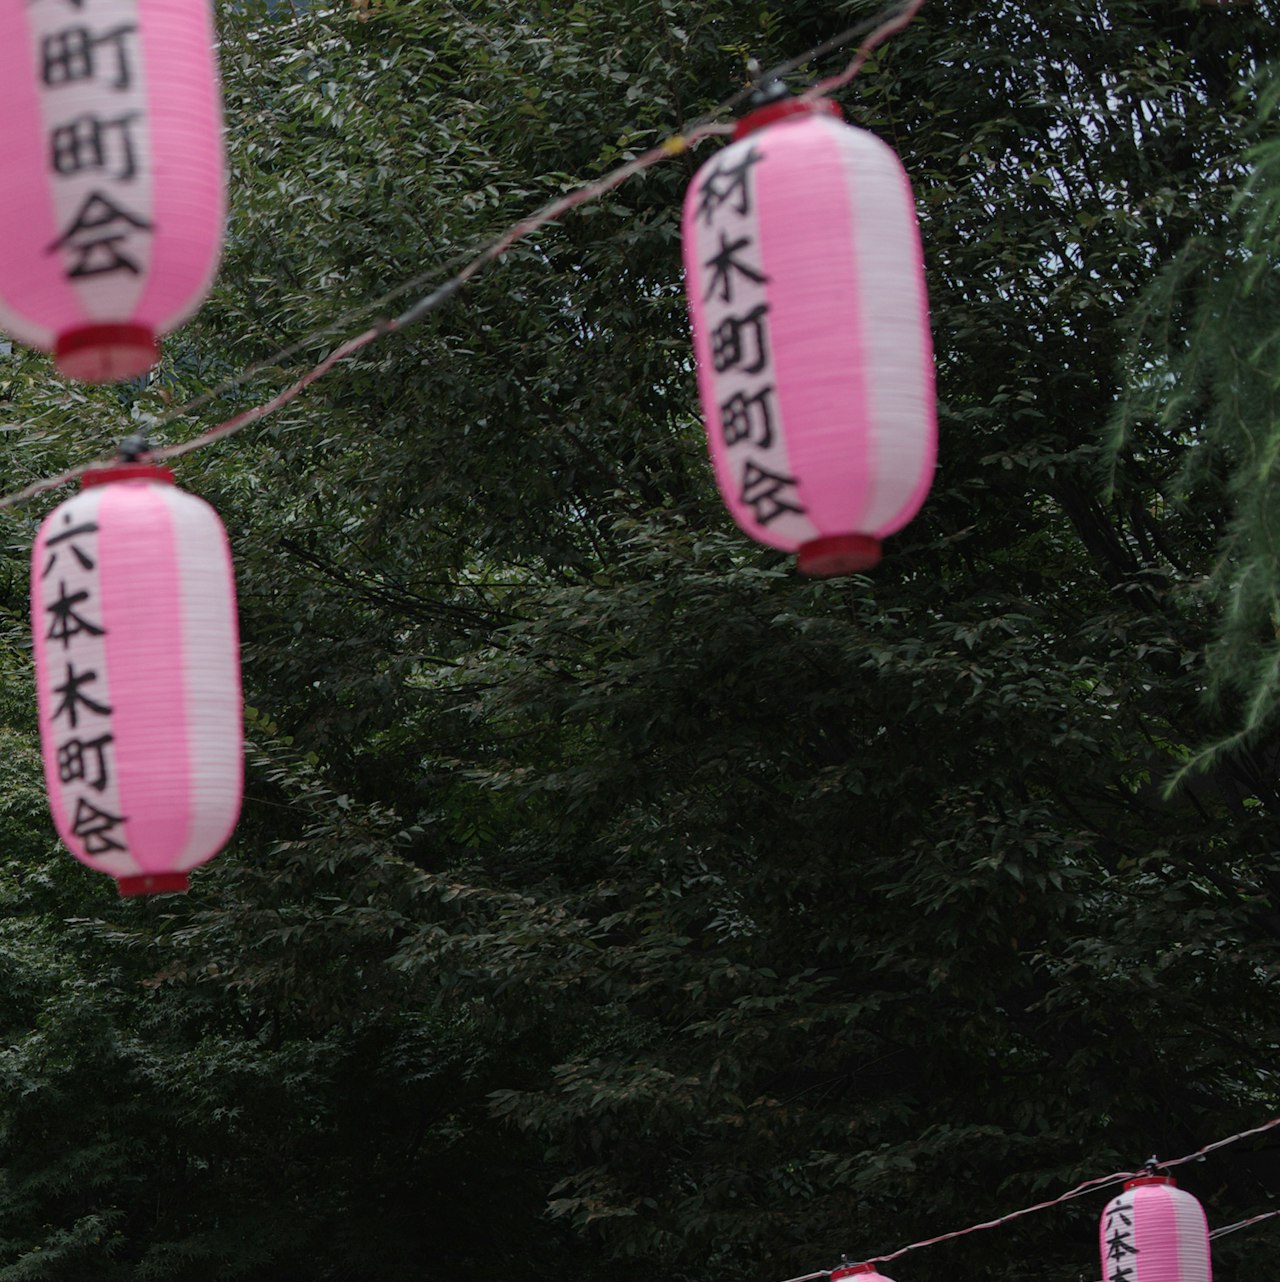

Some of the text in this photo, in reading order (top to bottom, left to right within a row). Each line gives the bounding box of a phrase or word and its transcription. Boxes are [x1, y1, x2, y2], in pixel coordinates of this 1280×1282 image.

[41, 0, 158, 281] 町町会
[695, 142, 809, 527] 材木町町会
[41, 513, 128, 857] 六本木町会
